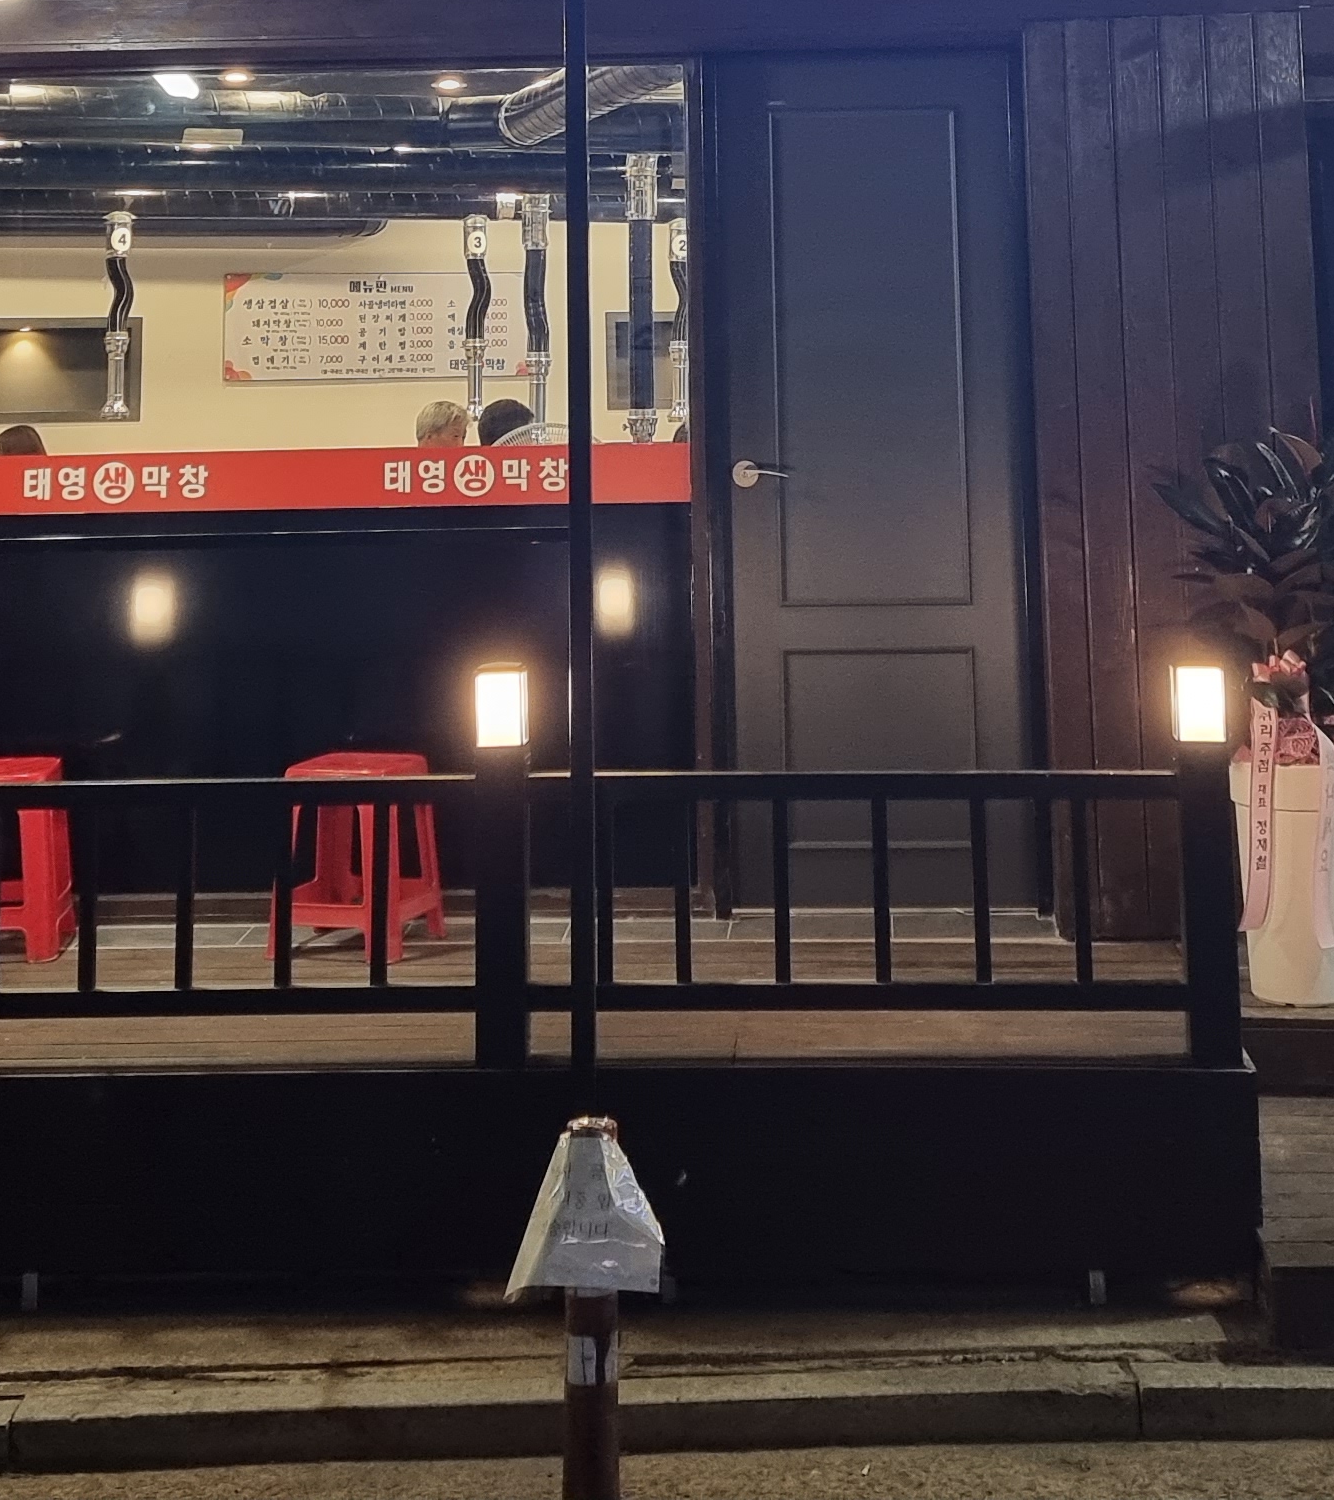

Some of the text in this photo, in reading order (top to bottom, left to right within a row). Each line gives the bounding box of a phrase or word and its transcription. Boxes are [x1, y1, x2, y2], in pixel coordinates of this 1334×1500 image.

[117, 234, 128, 247] 4
[473, 235, 483, 249] 3
[348, 279, 388, 294] 메뉴판
[317, 298, 350, 310] 10,000
[315, 318, 344, 329] 10,000
[317, 334, 350, 347] 15,000
[318, 354, 344, 365] 7,000
